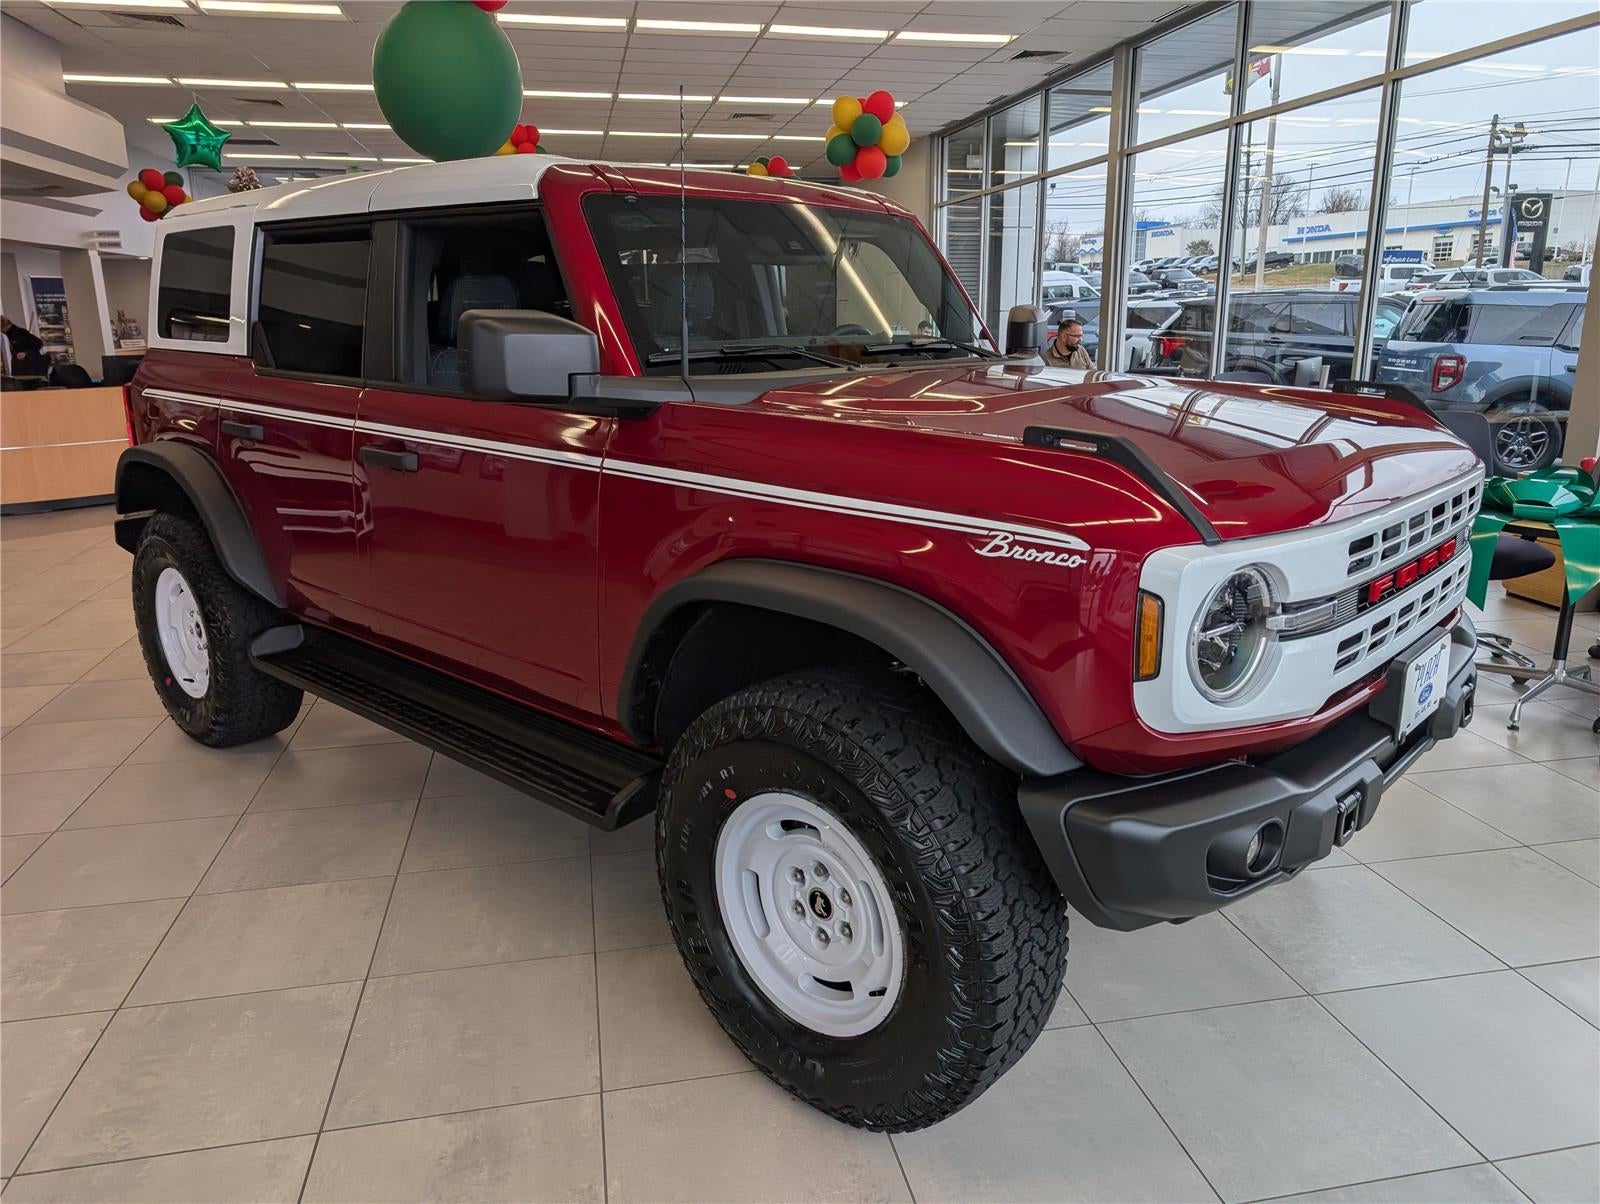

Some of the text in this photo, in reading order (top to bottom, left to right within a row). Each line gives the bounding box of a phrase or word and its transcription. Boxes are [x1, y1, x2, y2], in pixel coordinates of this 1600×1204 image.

[1151, 229, 1175, 238] HONDA
[1296, 224, 1332, 234] HONDA
[974, 529, 1088, 568] Bronco
[1367, 538, 1457, 604] FORD
[1414, 651, 1441, 692] PLAZA
